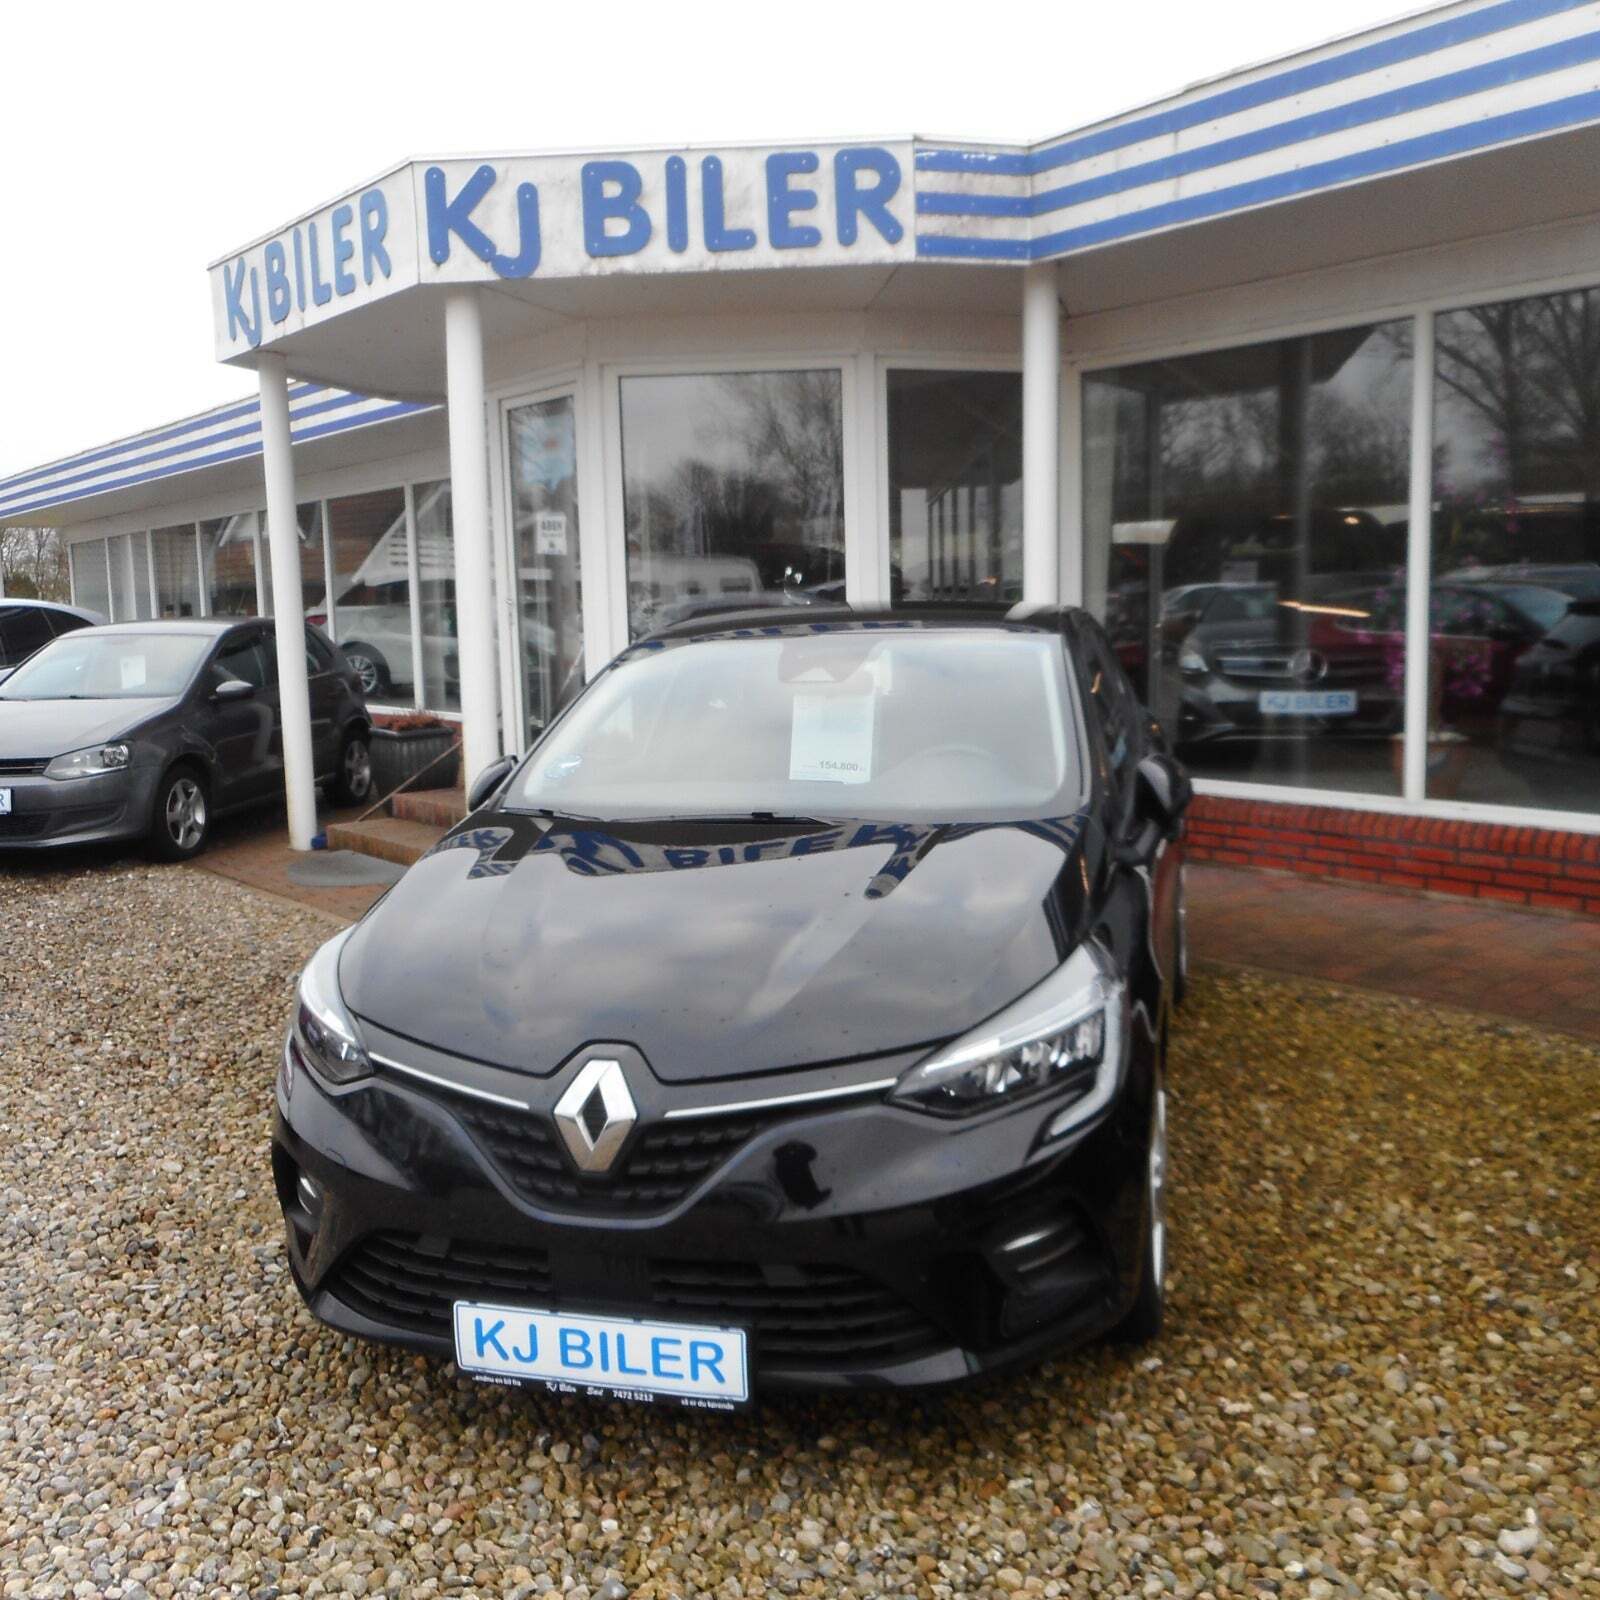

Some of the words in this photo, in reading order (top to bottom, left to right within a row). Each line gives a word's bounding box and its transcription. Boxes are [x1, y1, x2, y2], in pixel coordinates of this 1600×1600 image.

[223, 256, 263, 349] KJ
[264, 188, 392, 325] BILER
[424, 164, 541, 279] KJ
[581, 146, 904, 258] BILER
[473, 1317, 539, 1363] KJ
[558, 1327, 727, 1384] BILER
